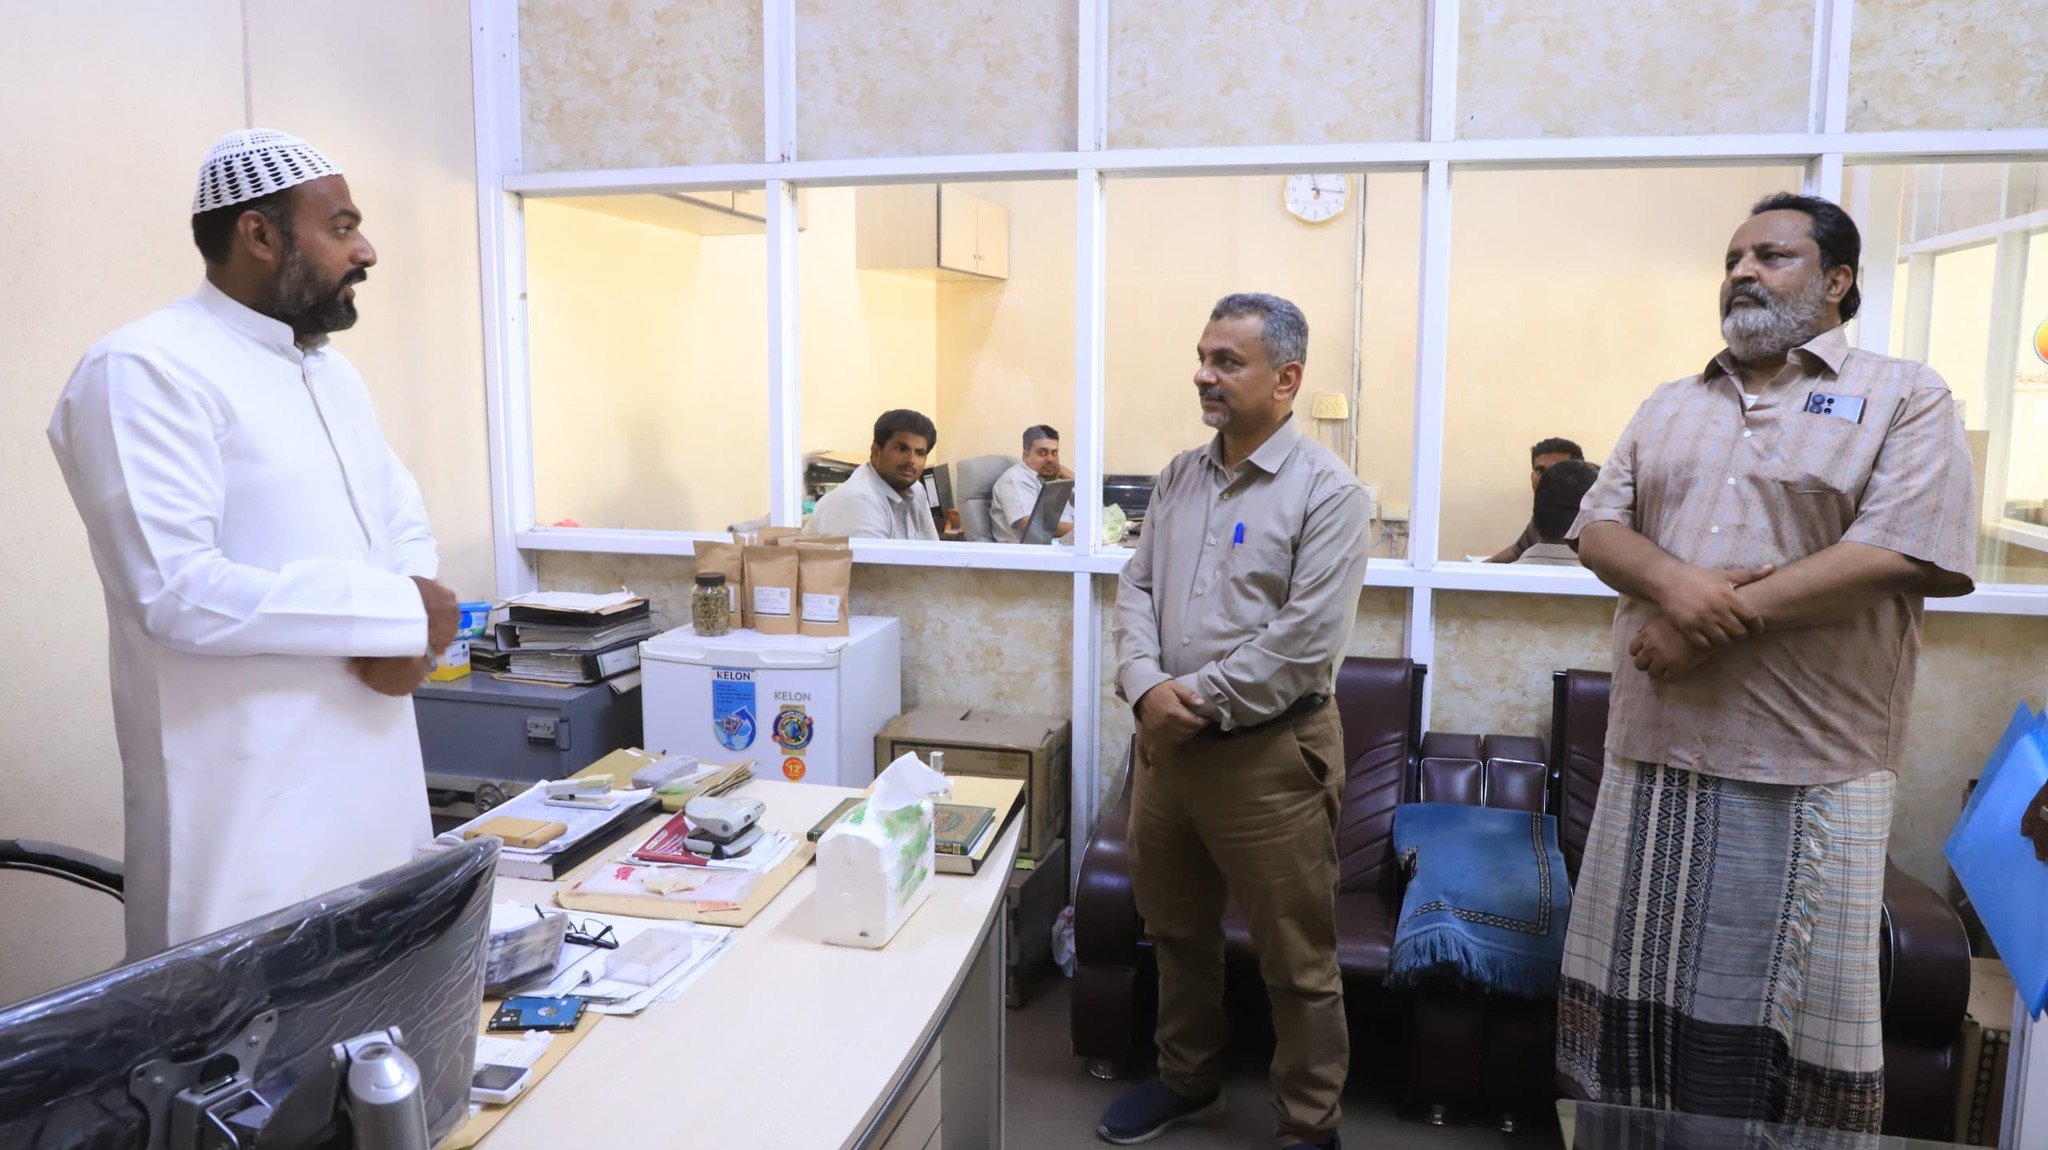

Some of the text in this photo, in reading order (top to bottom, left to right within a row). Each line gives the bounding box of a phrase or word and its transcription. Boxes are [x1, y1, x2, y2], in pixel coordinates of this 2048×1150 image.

[716, 671, 751, 681] KELON
[774, 691, 811, 701] KELON
[788, 766, 801, 774] 12
